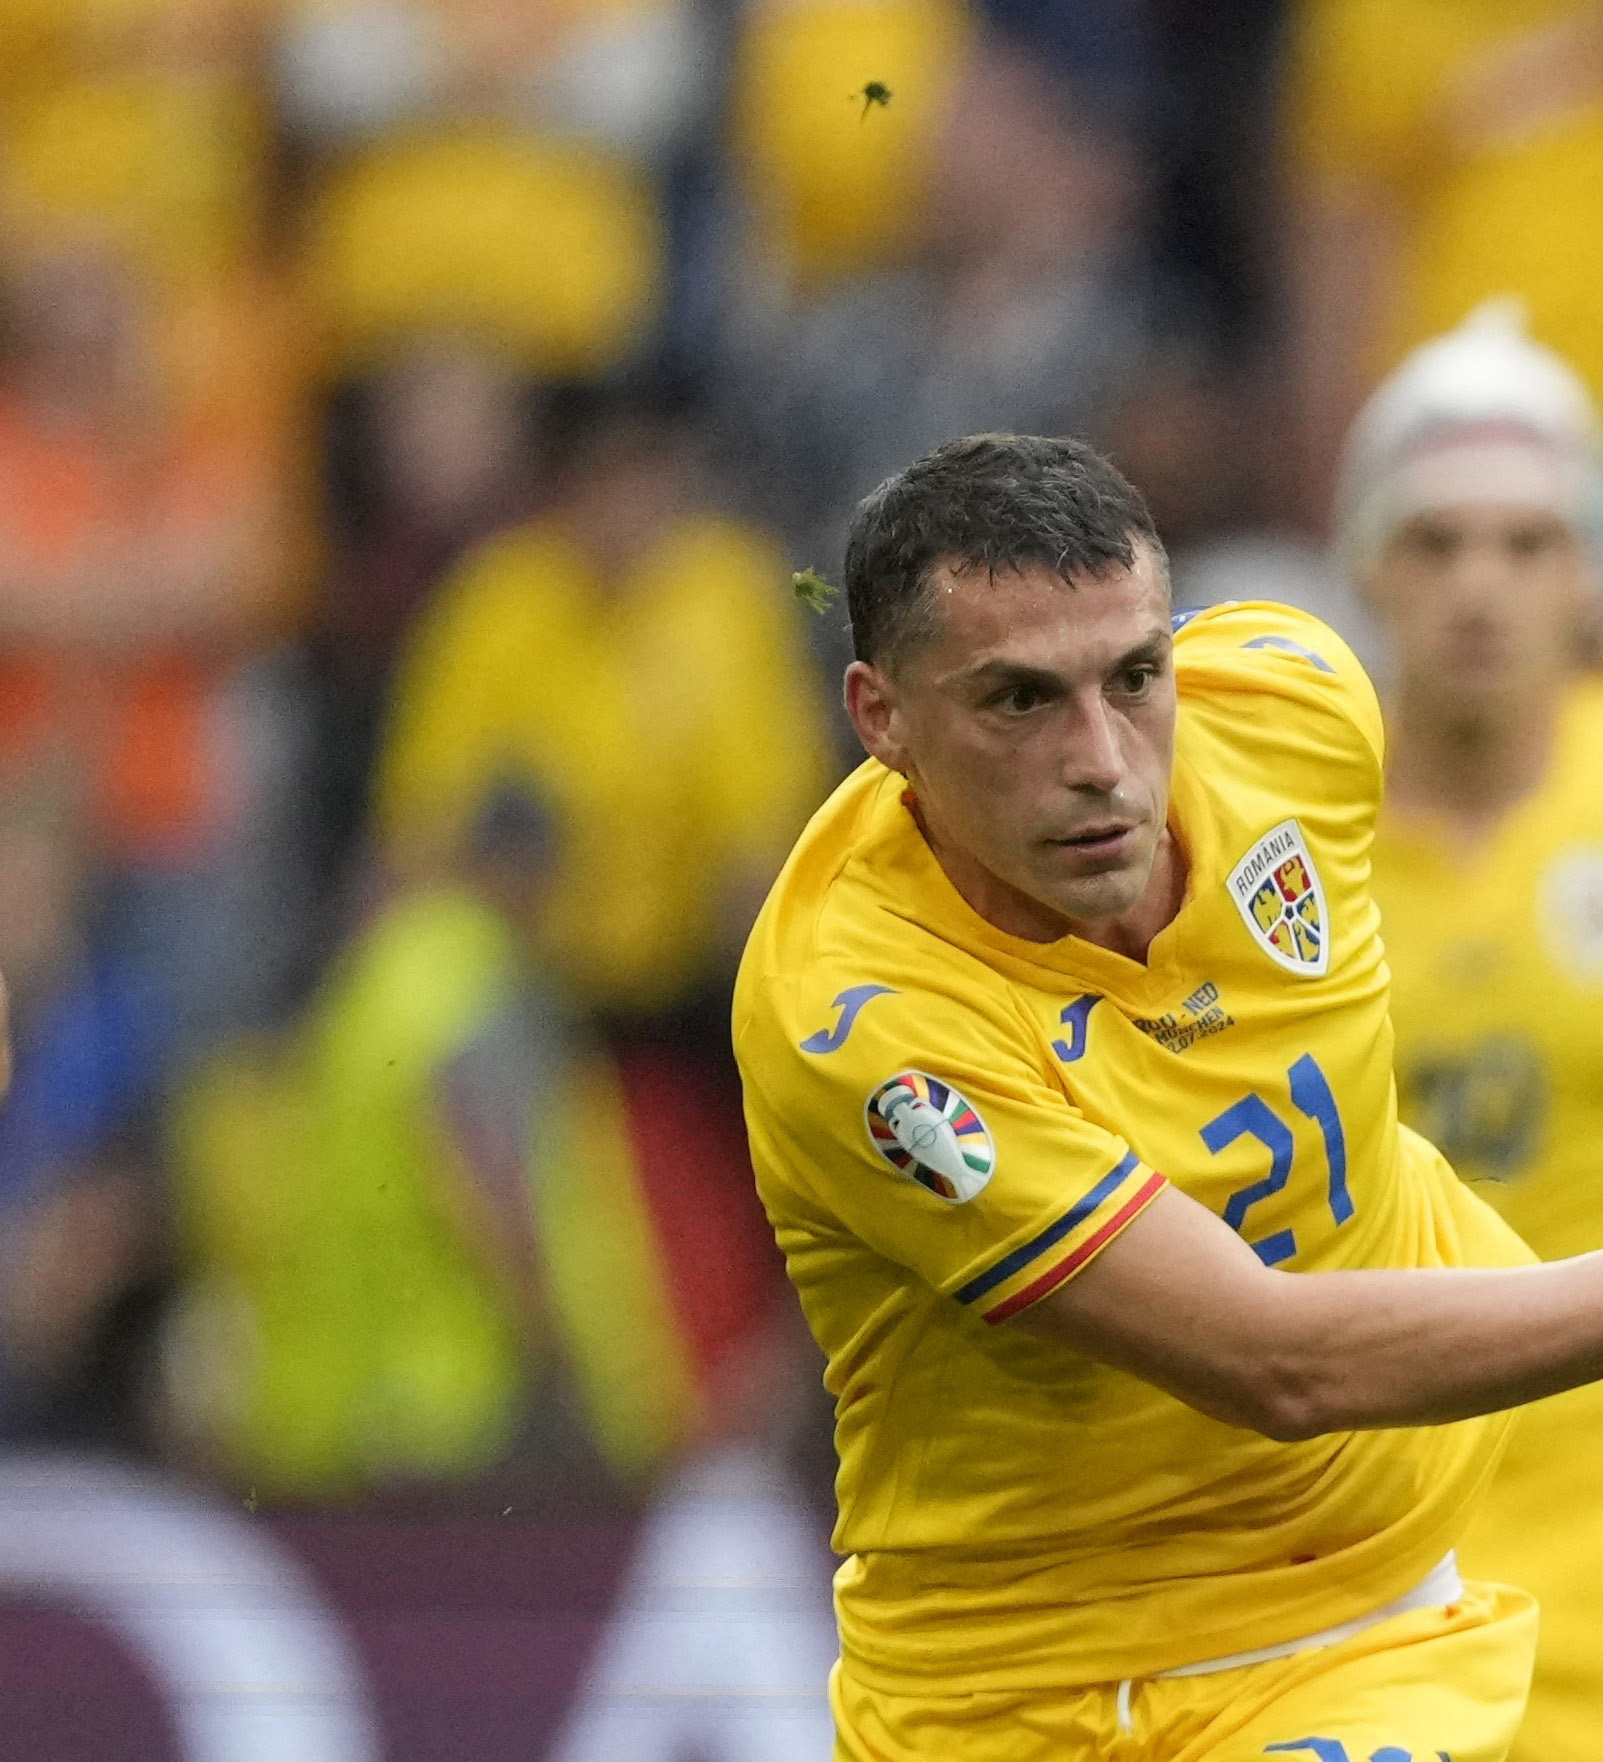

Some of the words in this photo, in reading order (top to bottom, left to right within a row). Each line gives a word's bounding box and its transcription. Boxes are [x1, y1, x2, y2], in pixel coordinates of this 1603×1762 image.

[1236, 830, 1295, 897] ROMÂNIA
[1182, 981, 1220, 1016] NED
[1198, 1052, 1355, 1268] 21
